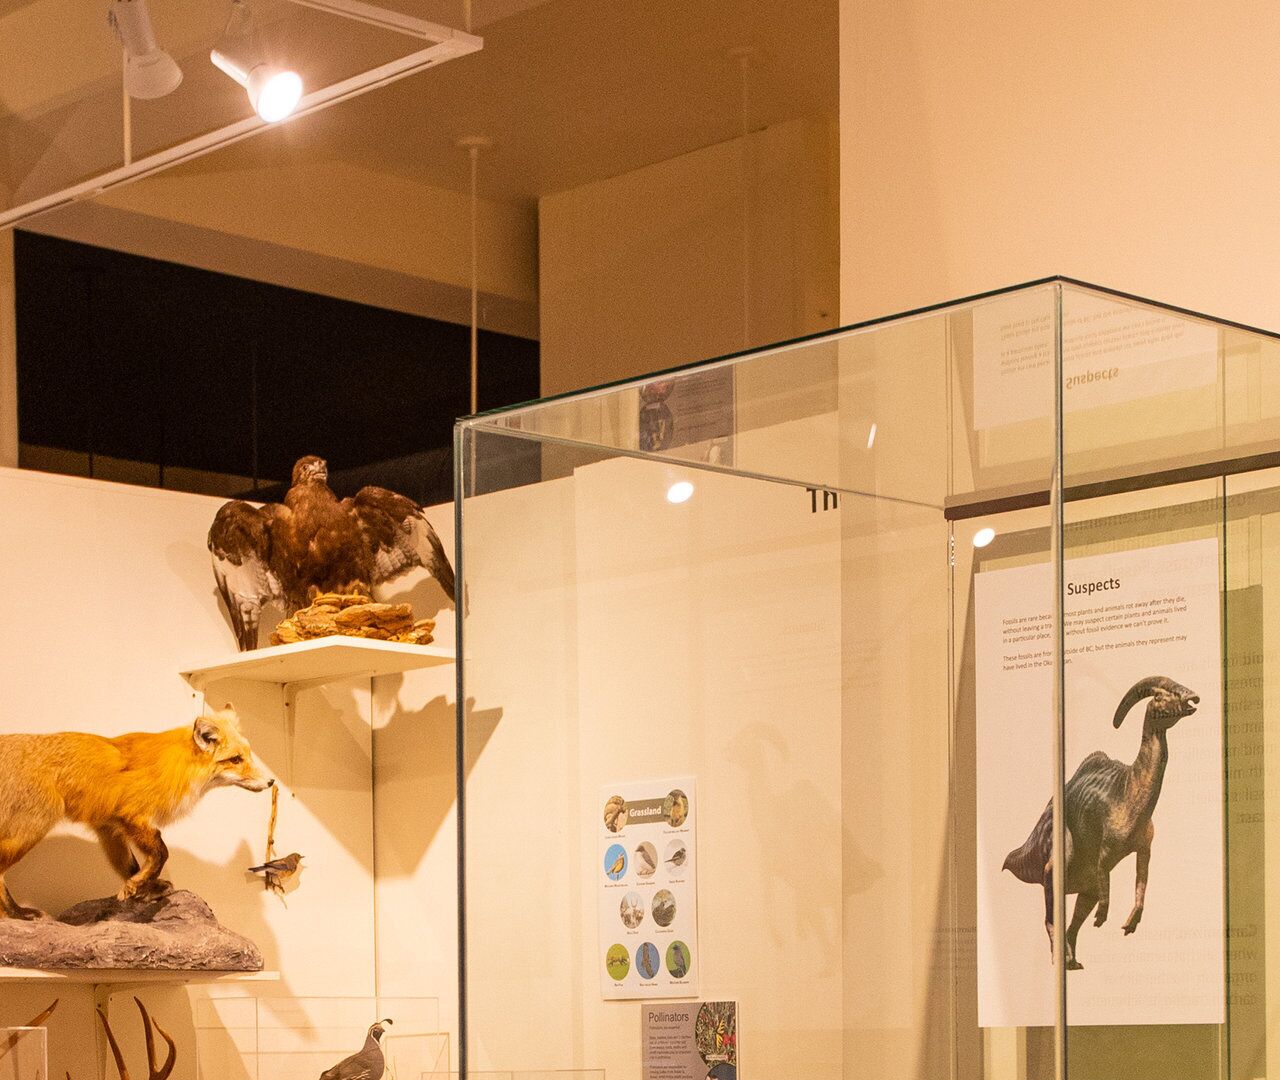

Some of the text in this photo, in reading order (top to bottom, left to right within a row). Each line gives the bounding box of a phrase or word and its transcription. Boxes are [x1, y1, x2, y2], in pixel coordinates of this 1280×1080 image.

[1067, 577, 1120, 595] Suspects
[629, 806, 662, 817] Grassland
[648, 1012, 689, 1022] Pollinators
